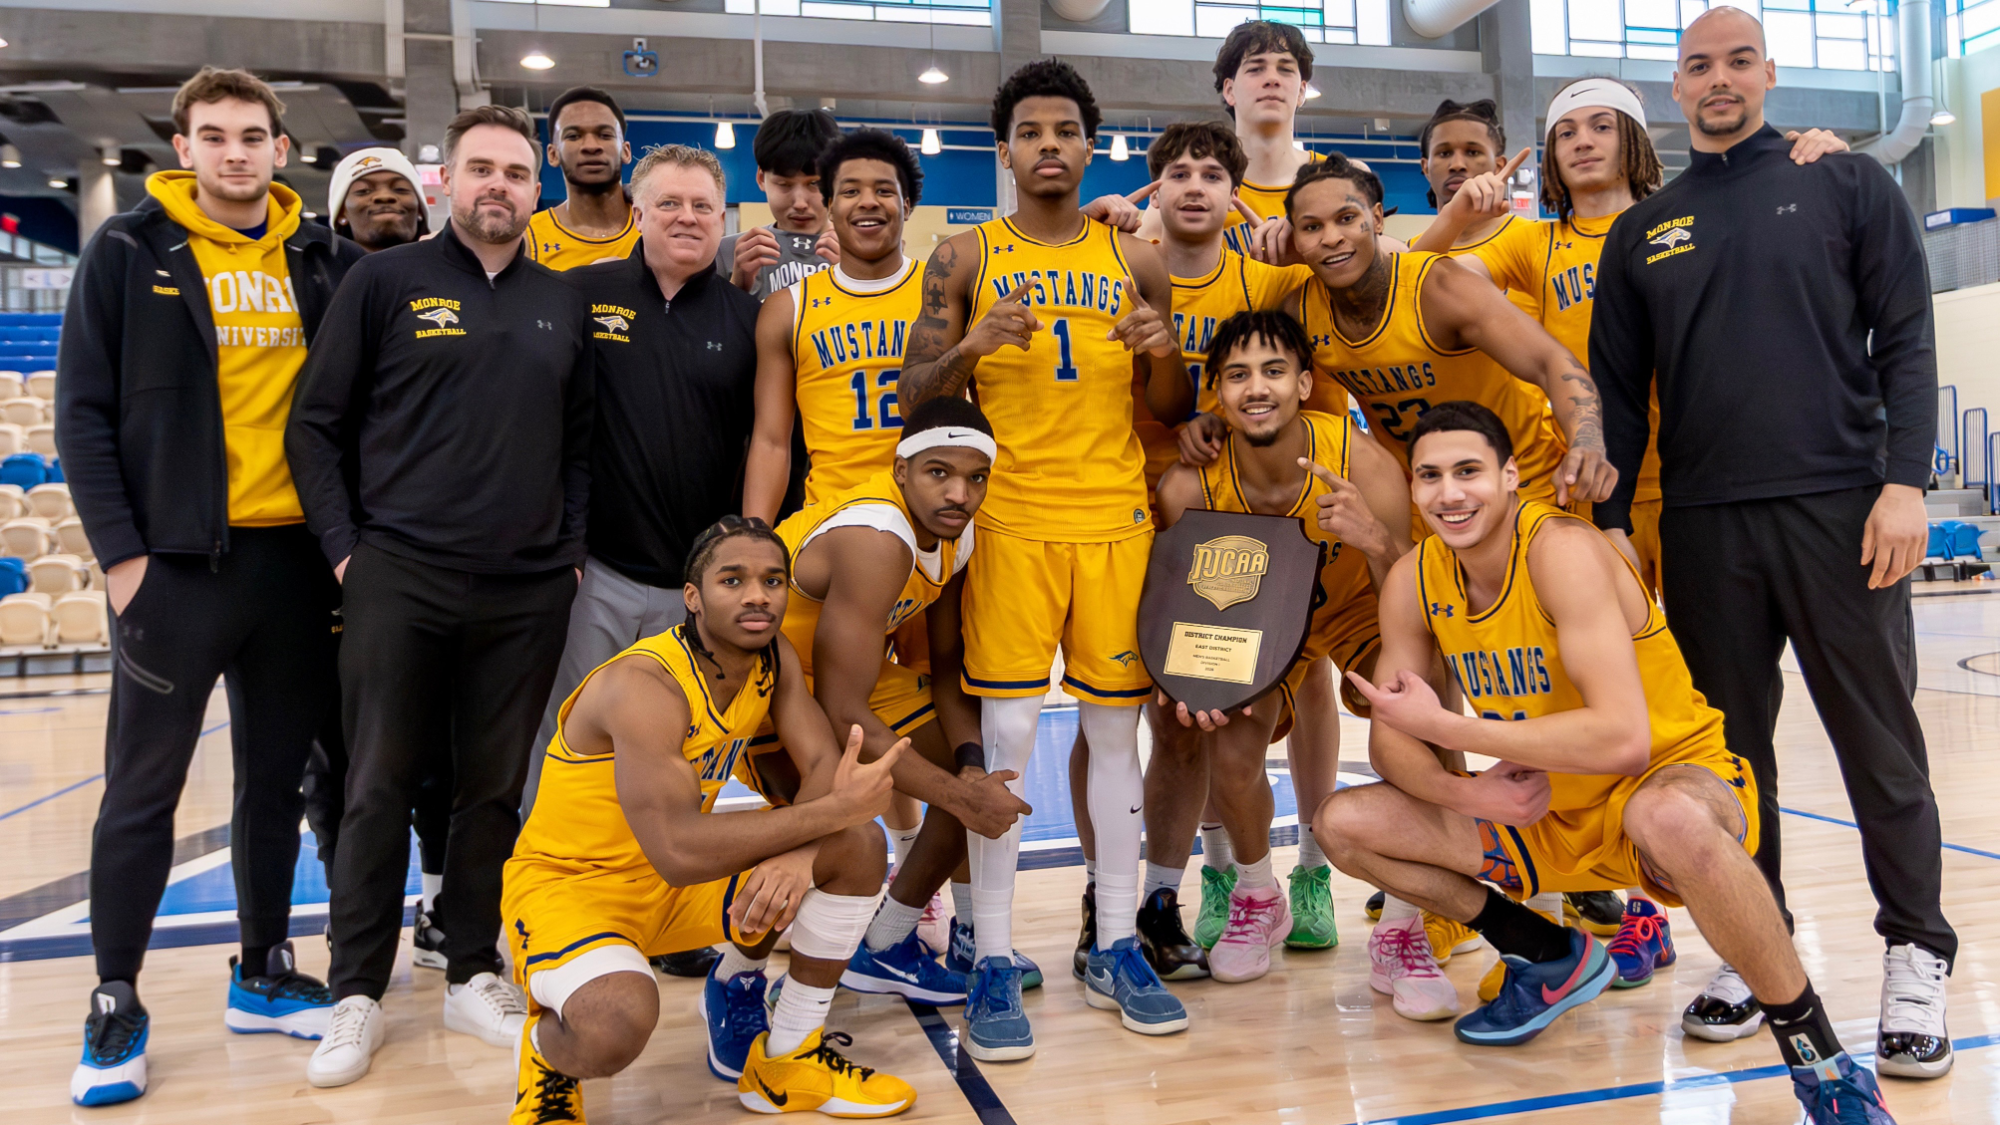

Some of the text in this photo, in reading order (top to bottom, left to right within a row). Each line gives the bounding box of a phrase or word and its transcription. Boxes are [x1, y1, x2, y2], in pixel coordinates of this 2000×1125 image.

[955, 212, 991, 221] WOMEN
[1646, 215, 1695, 240] MONROE
[1646, 242, 1696, 265] BASKETBALL
[204, 270, 299, 313] ONR
[992, 270, 1123, 316] MUSTANGS
[410, 297, 461, 312] MONROE
[591, 304, 637, 320] MONROE
[415, 328, 467, 339] BASKETBALL
[811, 319, 914, 370] MUSTAN
[1051, 317, 1079, 382] 1
[850, 368, 906, 433] 12
[1191, 548, 1266, 581] NJCAA
[1184, 631, 1248, 644] DISTRICT CHAMPION
